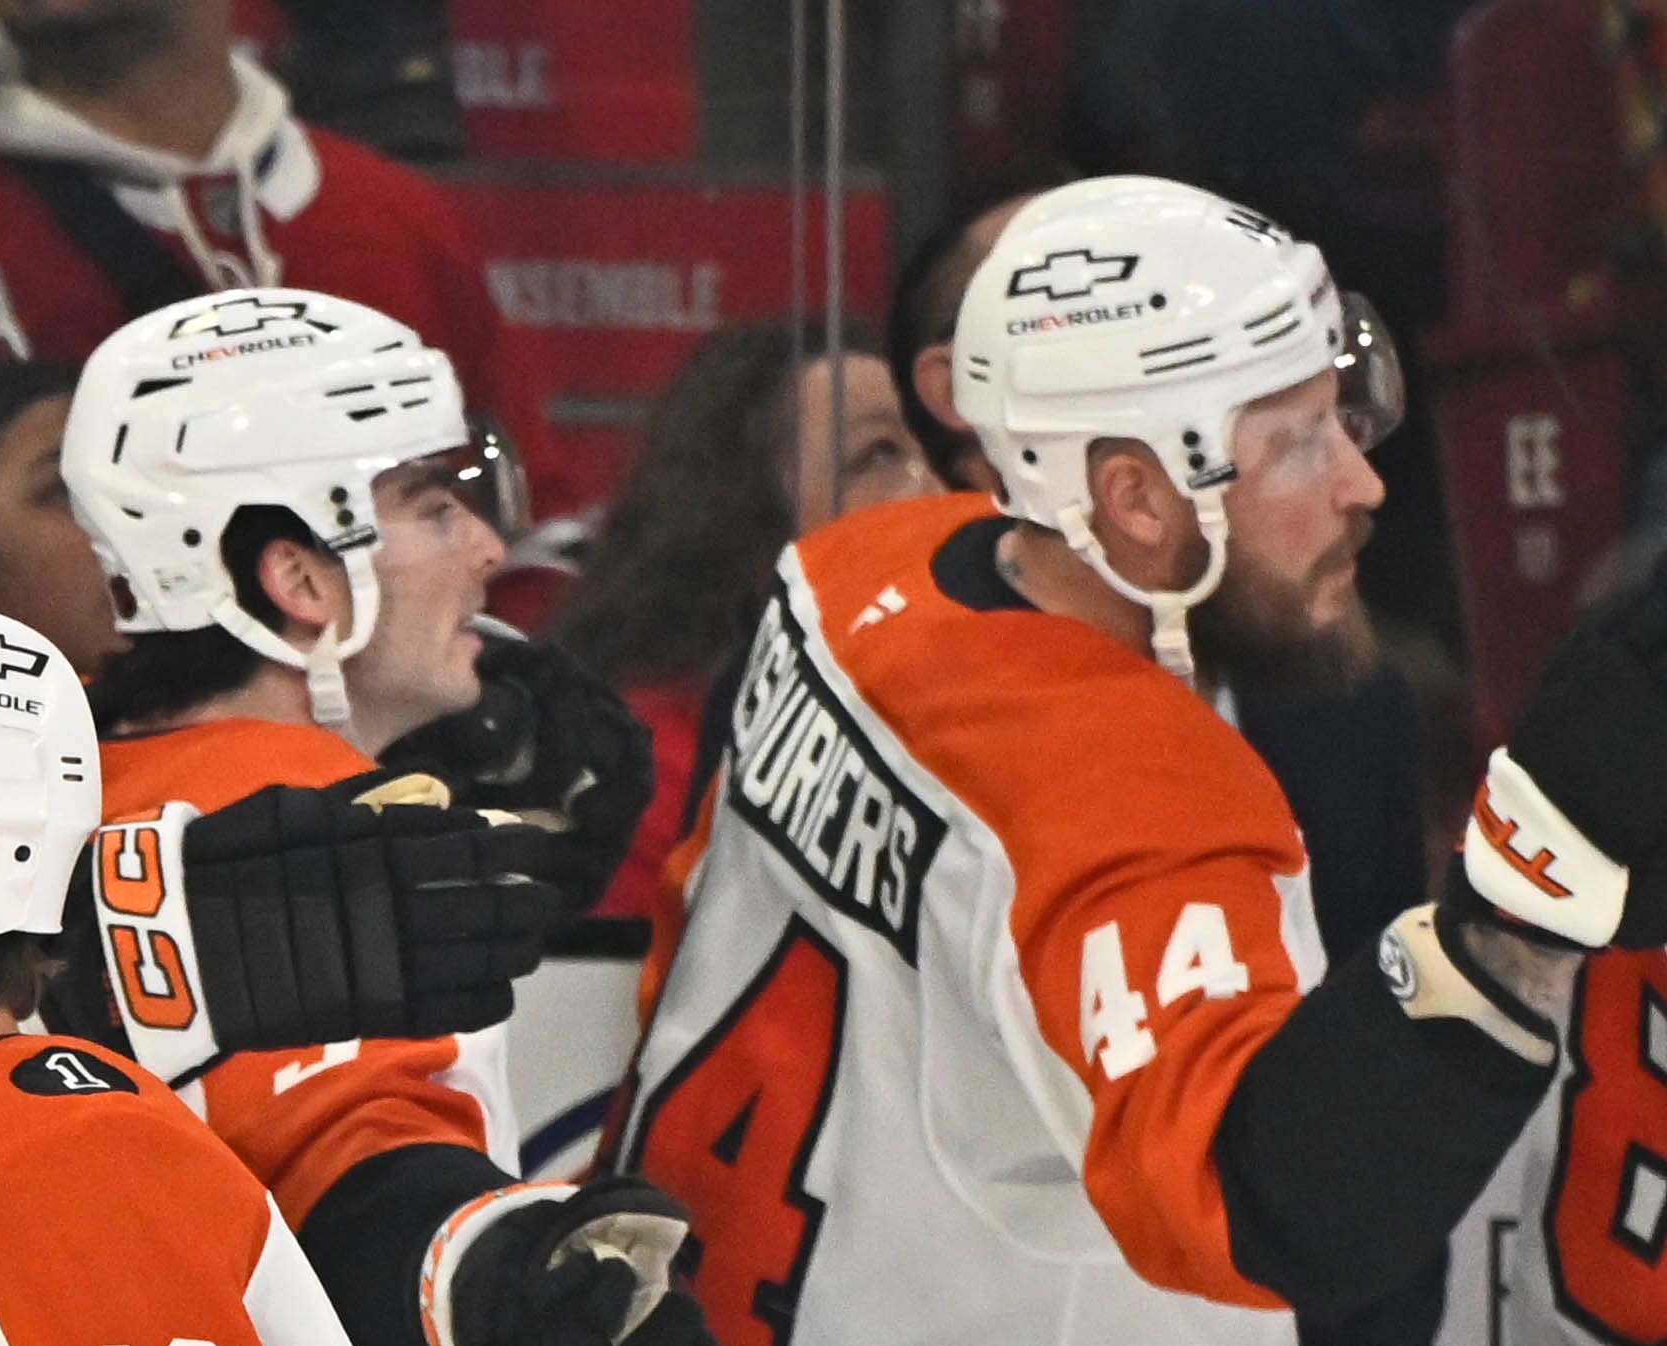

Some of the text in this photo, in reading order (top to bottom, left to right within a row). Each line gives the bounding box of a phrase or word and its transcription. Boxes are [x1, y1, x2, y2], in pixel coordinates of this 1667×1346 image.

[171, 333, 317, 370] CHEVROLET
[1007, 303, 1145, 337] CHEVROLET
[97, 805, 198, 1032] CC
[1079, 902, 1249, 1081] 44
